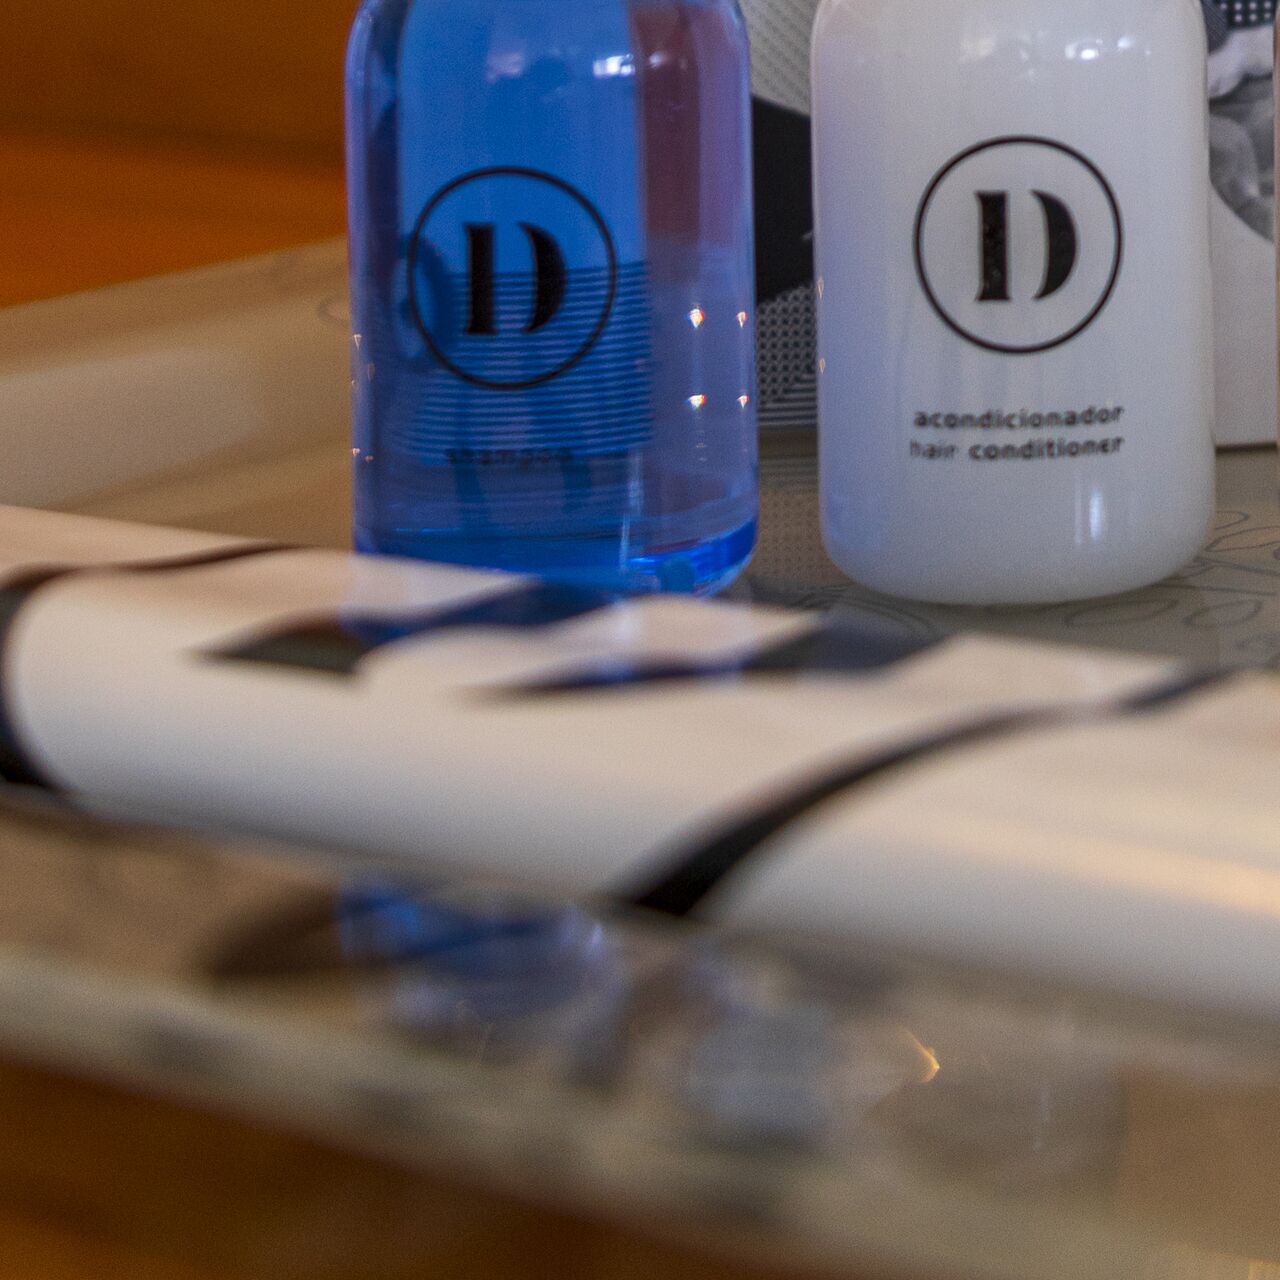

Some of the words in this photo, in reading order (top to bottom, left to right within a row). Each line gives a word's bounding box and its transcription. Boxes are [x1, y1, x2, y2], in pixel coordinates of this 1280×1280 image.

[914, 405, 1125, 429] acondicionador
[910, 439, 956, 460] hair
[969, 436, 1125, 461] conditioner
